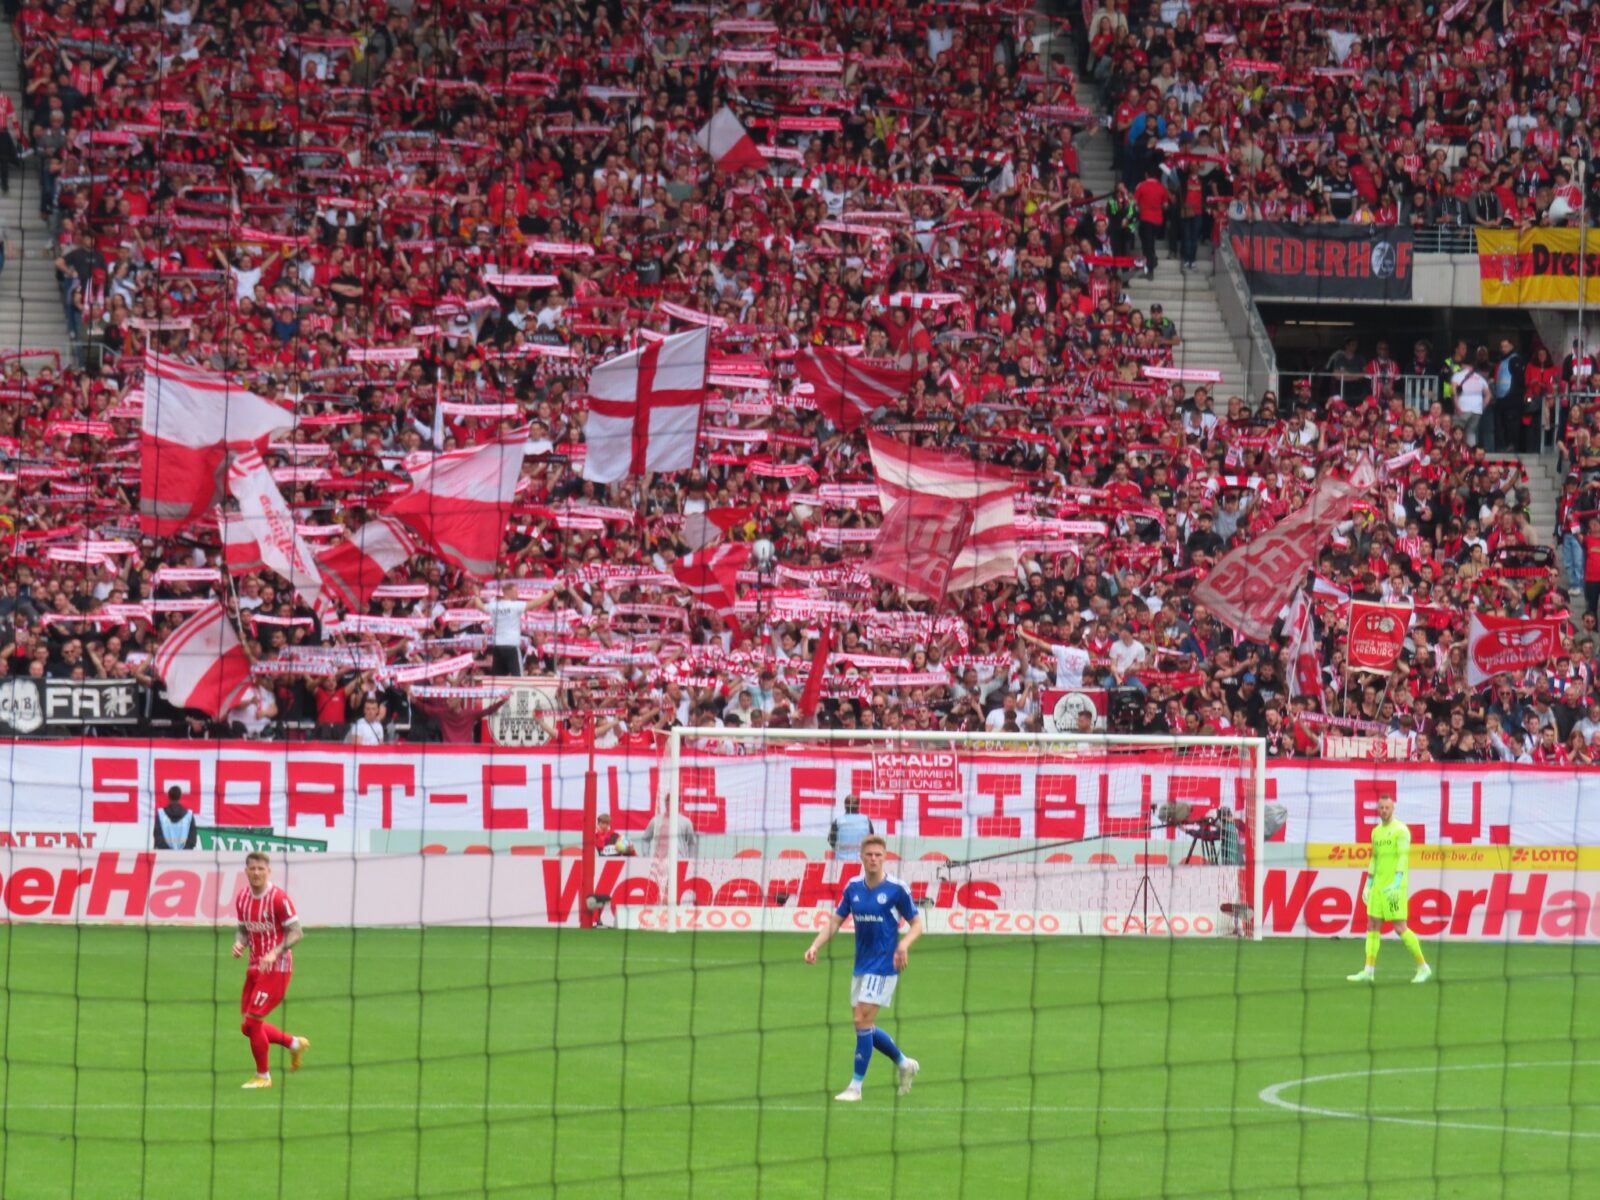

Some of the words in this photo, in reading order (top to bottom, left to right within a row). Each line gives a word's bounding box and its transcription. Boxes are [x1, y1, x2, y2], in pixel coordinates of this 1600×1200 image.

[878, 755, 953, 767] KHALID
[878, 767, 905, 778] FÜR
[909, 769, 953, 778] IMMER
[889, 780, 910, 789] BEI
[912, 780, 943, 789] UNS
[1420, 850, 1484, 864] lotto-bw.de
[1532, 848, 1578, 863] LOTTO
[948, 911, 1059, 932] CAZOO
[1103, 914, 1214, 935] CAZOO
[866, 975, 878, 991] 11
[254, 990, 269, 1007] 17
